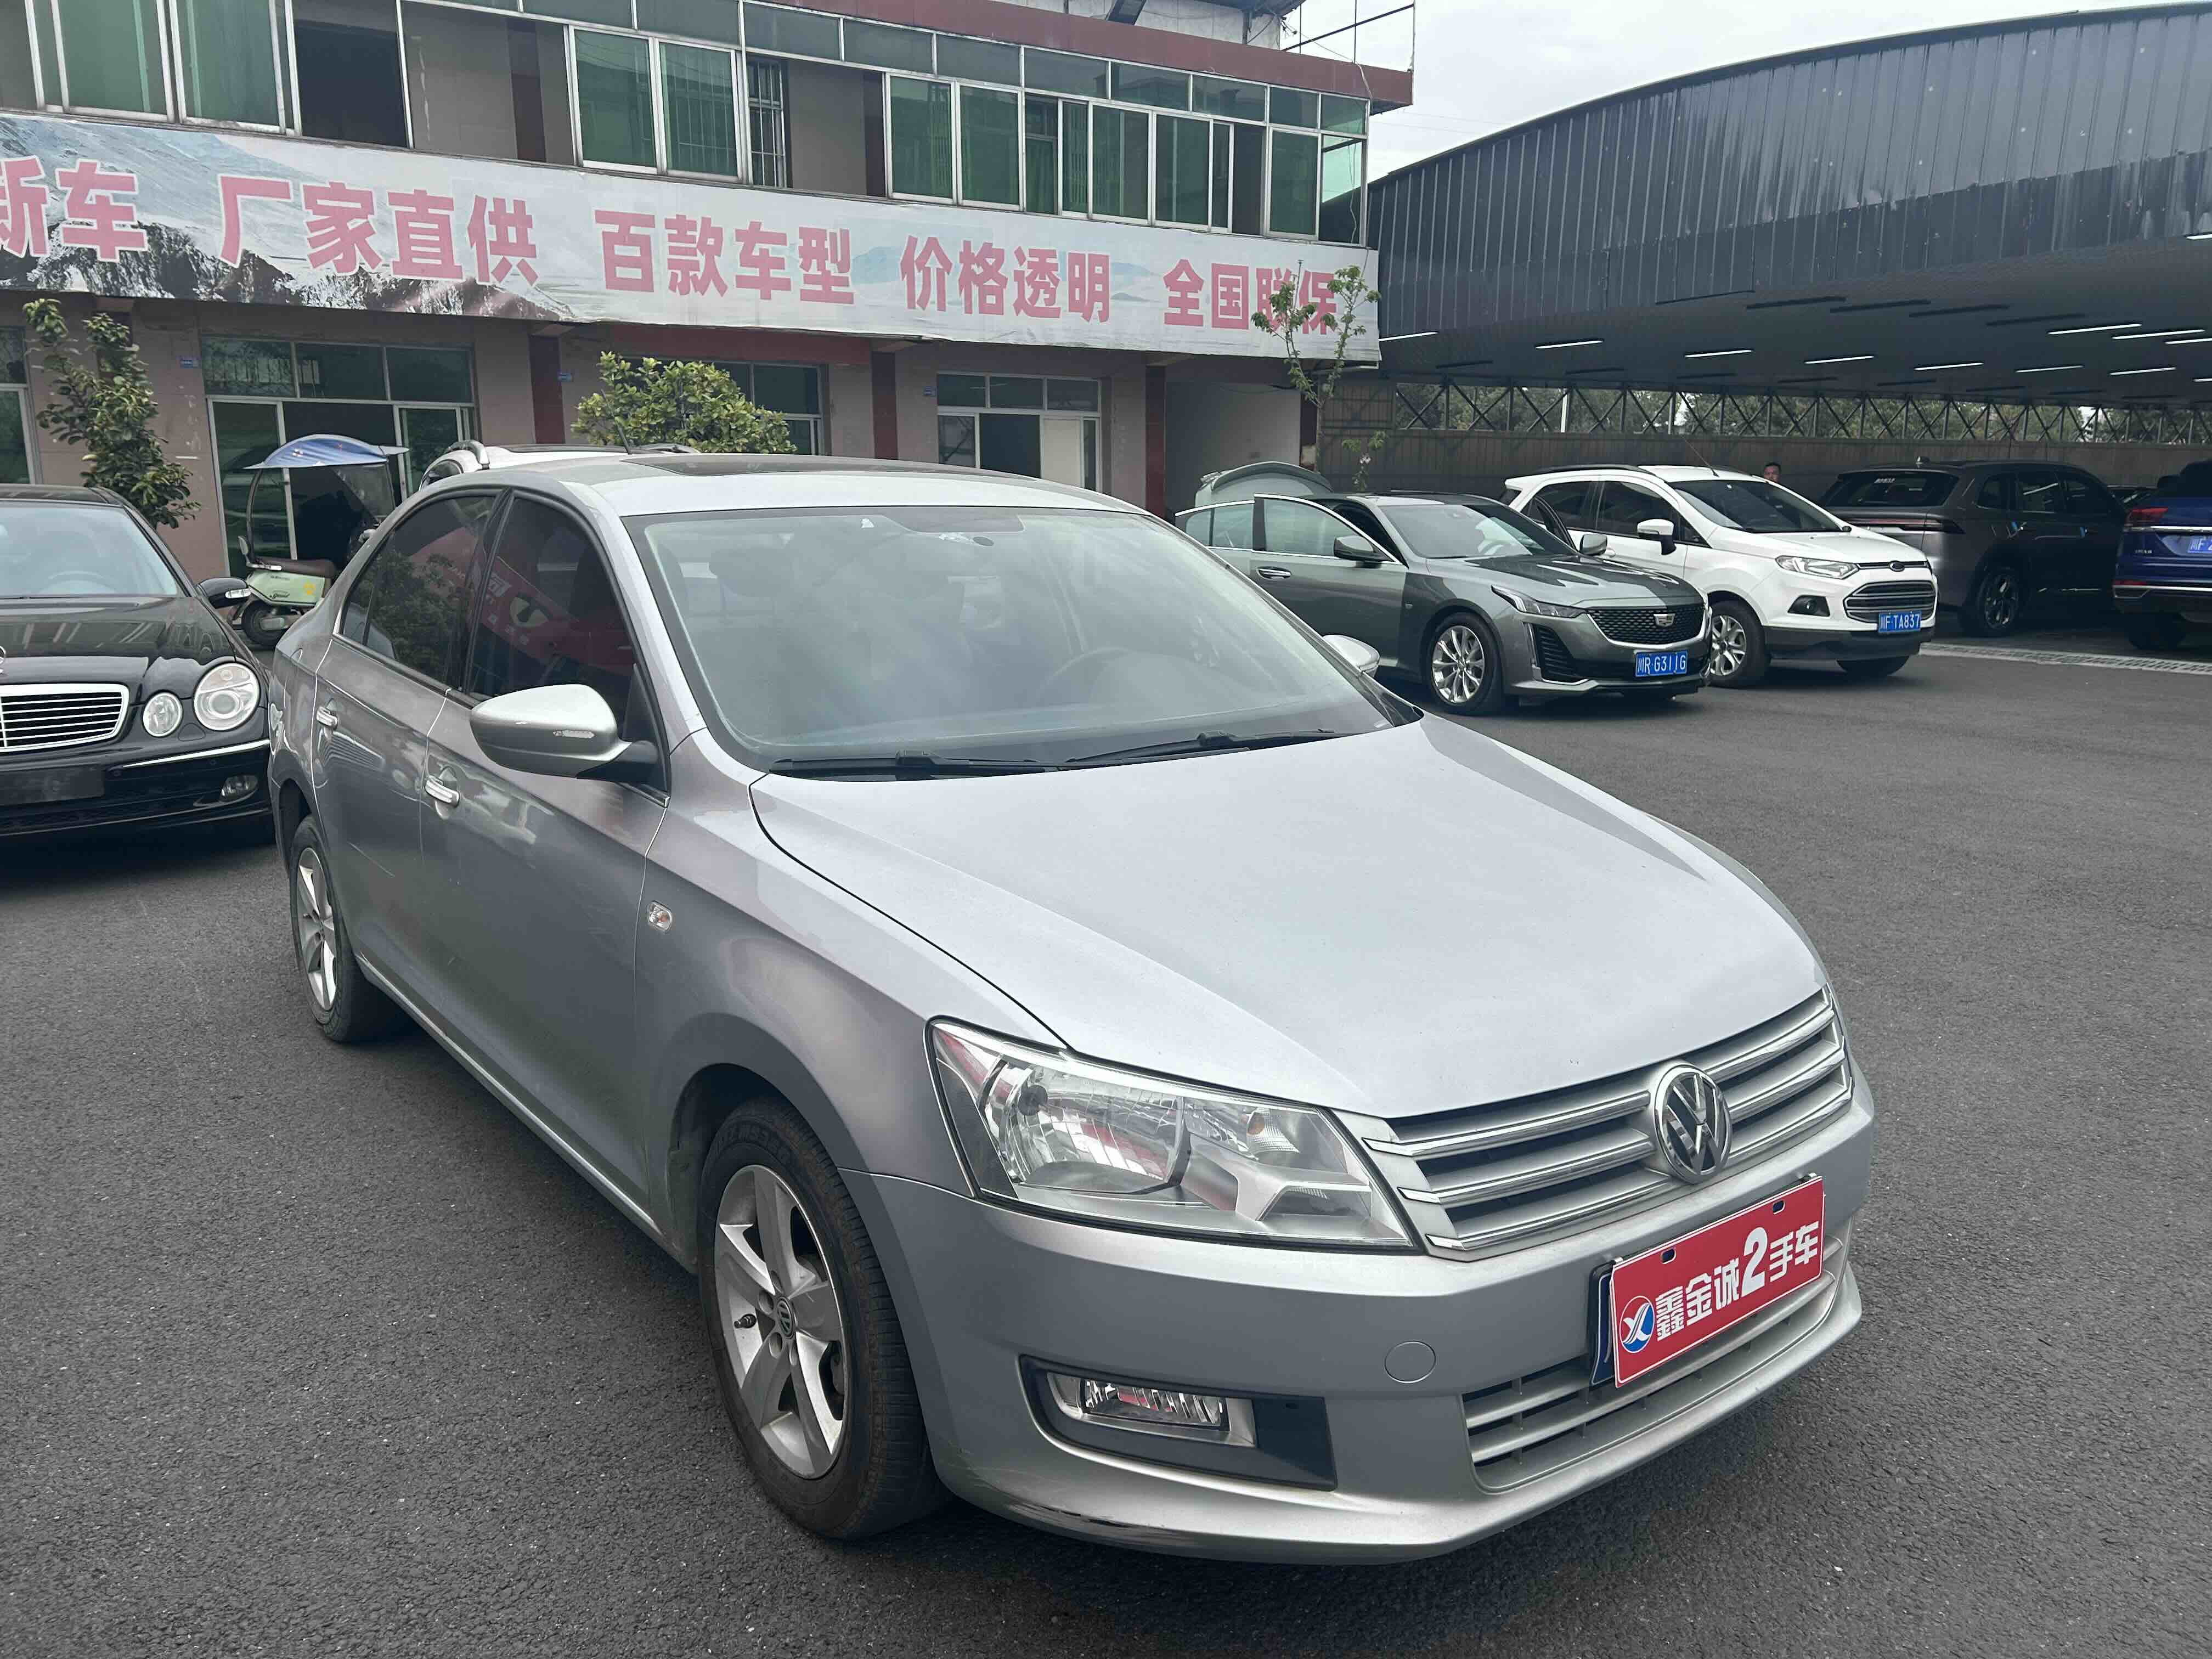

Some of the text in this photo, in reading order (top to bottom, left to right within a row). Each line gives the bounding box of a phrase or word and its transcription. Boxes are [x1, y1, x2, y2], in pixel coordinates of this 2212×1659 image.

[219, 174, 539, 286] 厂家直供
[595, 210, 854, 304] 百款车型
[900, 235, 1111, 324] 价格透明
[1655, 1221, 1819, 1341] 鑫金诚2手车
